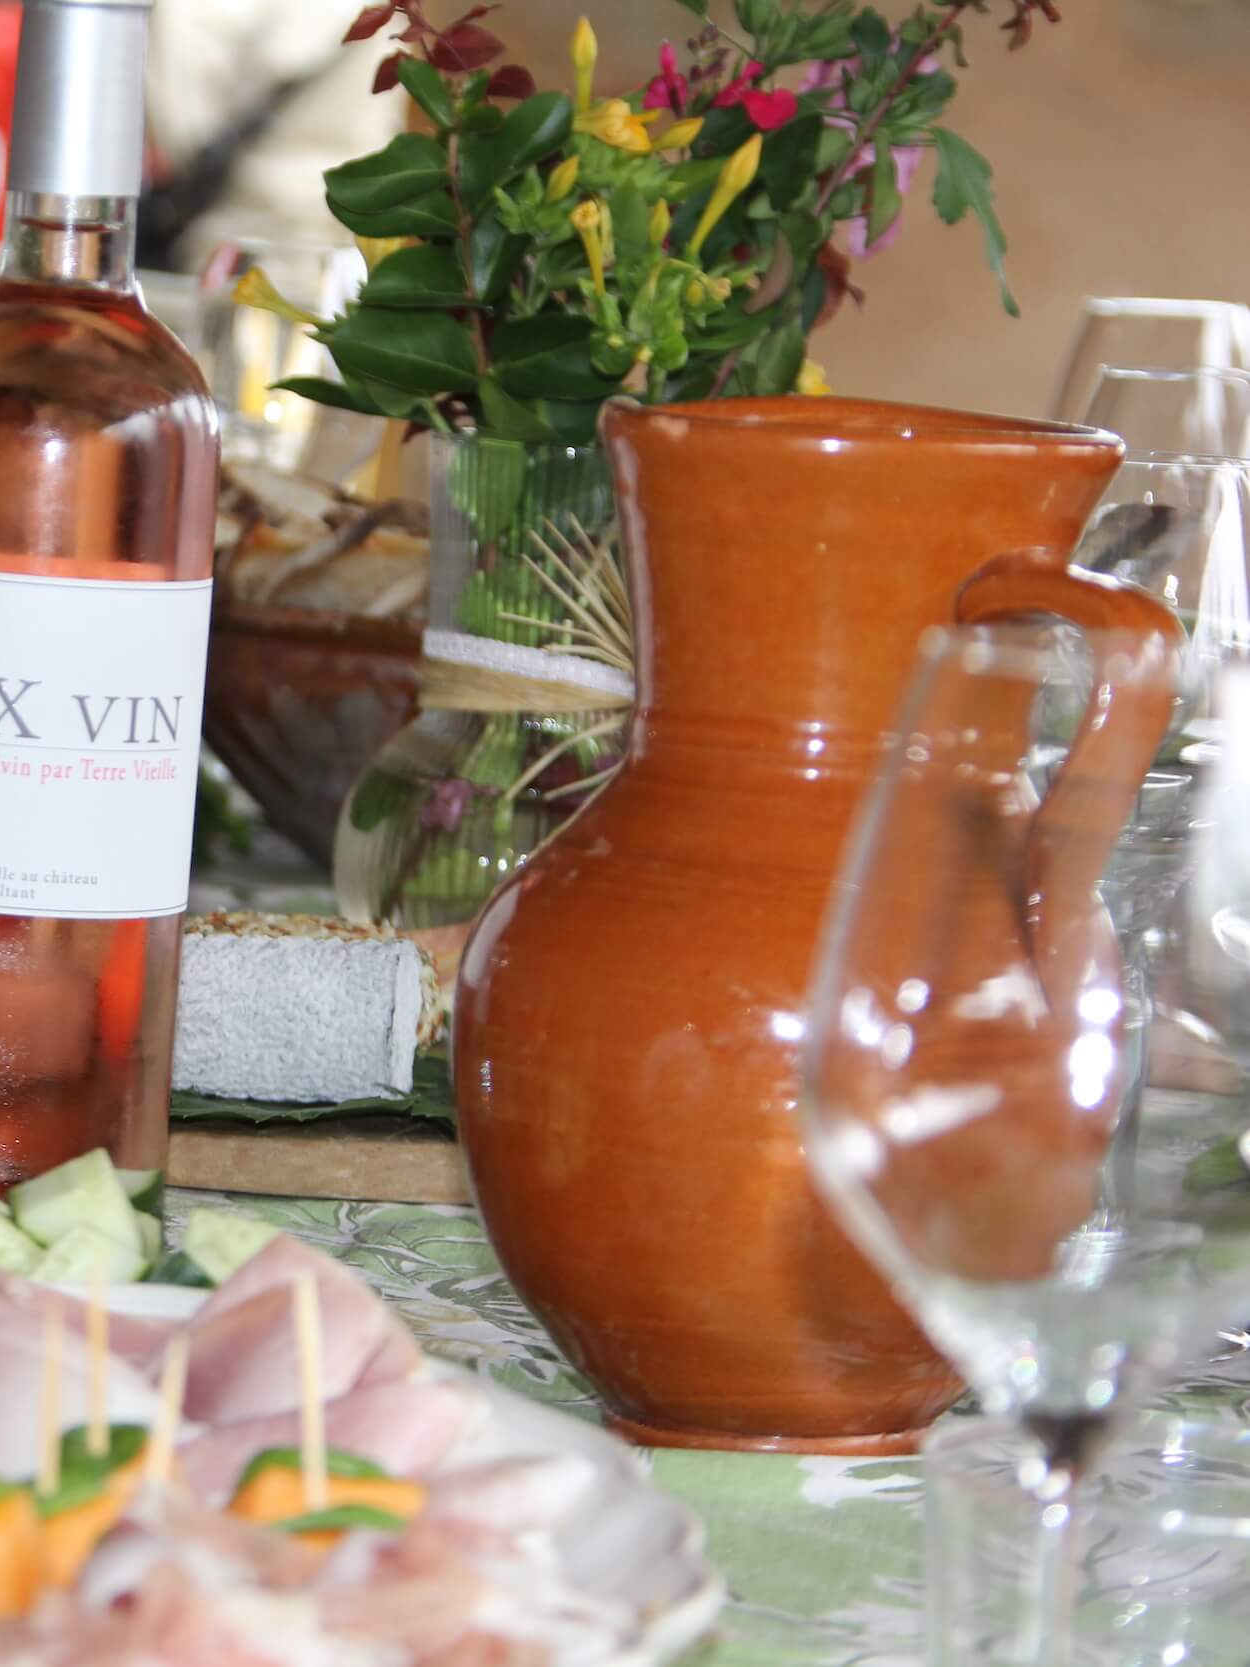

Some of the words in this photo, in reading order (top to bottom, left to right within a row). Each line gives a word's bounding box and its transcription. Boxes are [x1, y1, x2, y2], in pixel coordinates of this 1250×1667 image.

[71, 694, 183, 743] VIN
[40, 763, 73, 785] par
[79, 757, 127, 781] Terre
[133, 757, 178, 781] Vieille
[21, 872, 39, 883] au
[43, 870, 99, 885] château
